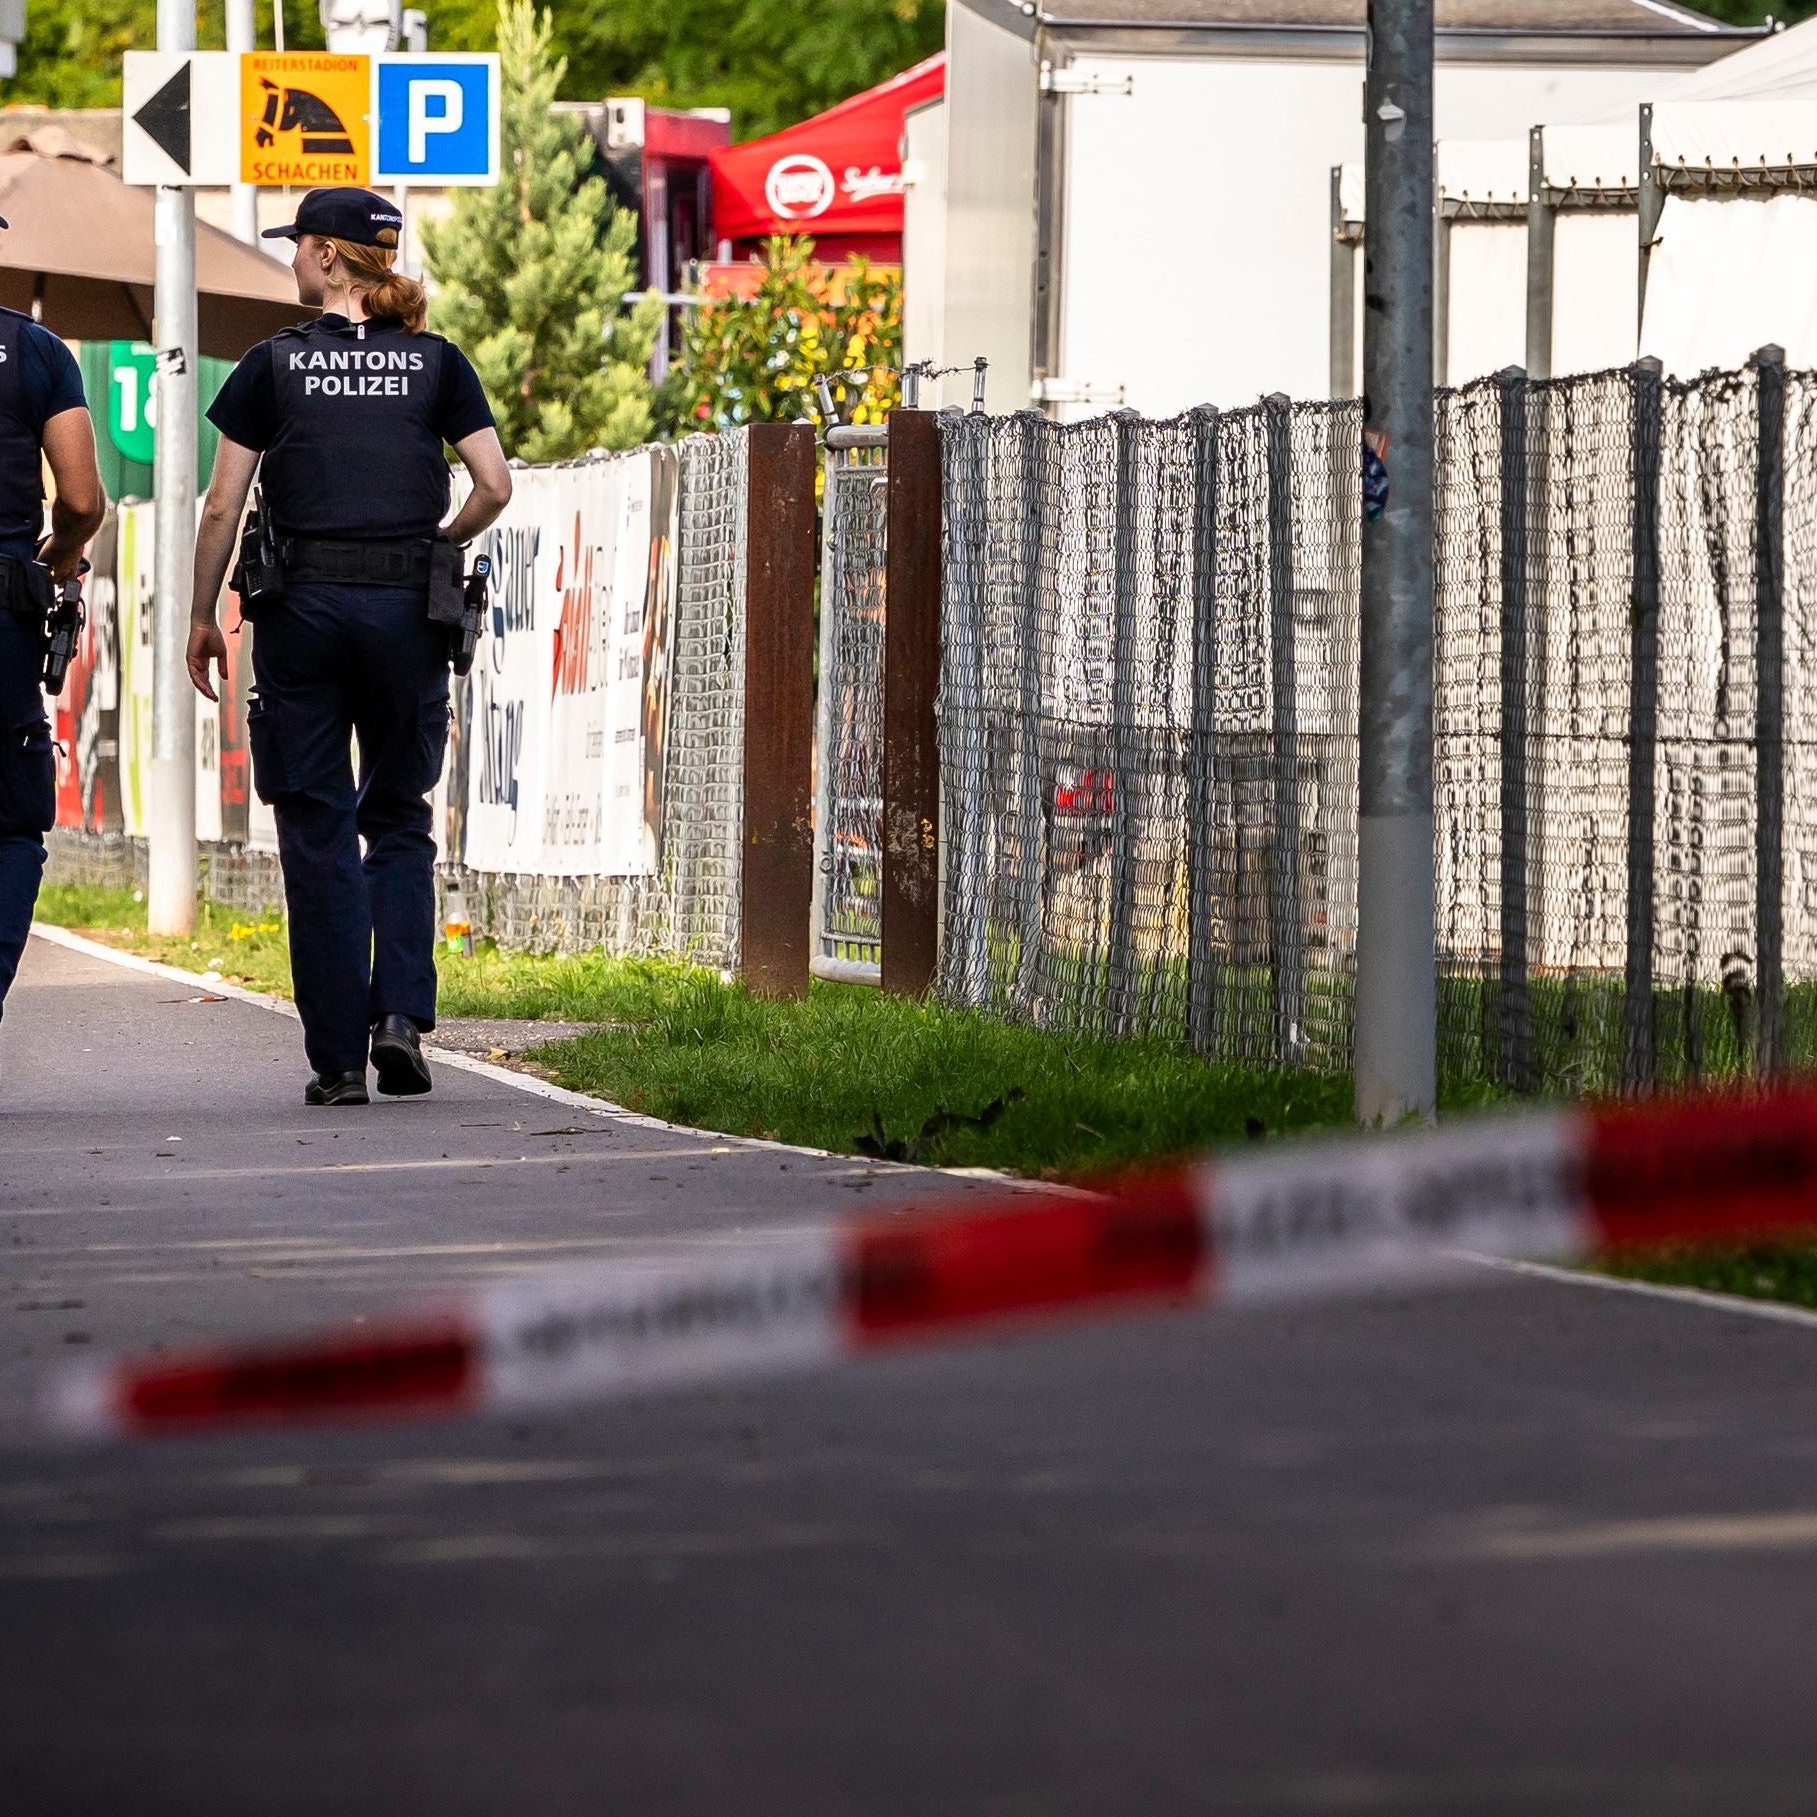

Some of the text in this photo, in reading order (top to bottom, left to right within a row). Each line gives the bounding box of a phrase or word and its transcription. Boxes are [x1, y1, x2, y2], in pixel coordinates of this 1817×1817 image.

[253, 58, 357, 72] REITERSTADION
[408, 79, 463, 163] P
[253, 162, 357, 180] SCHACHEN
[289, 351, 424, 371] KANTONS
[305, 376, 408, 396] POLIZEI
